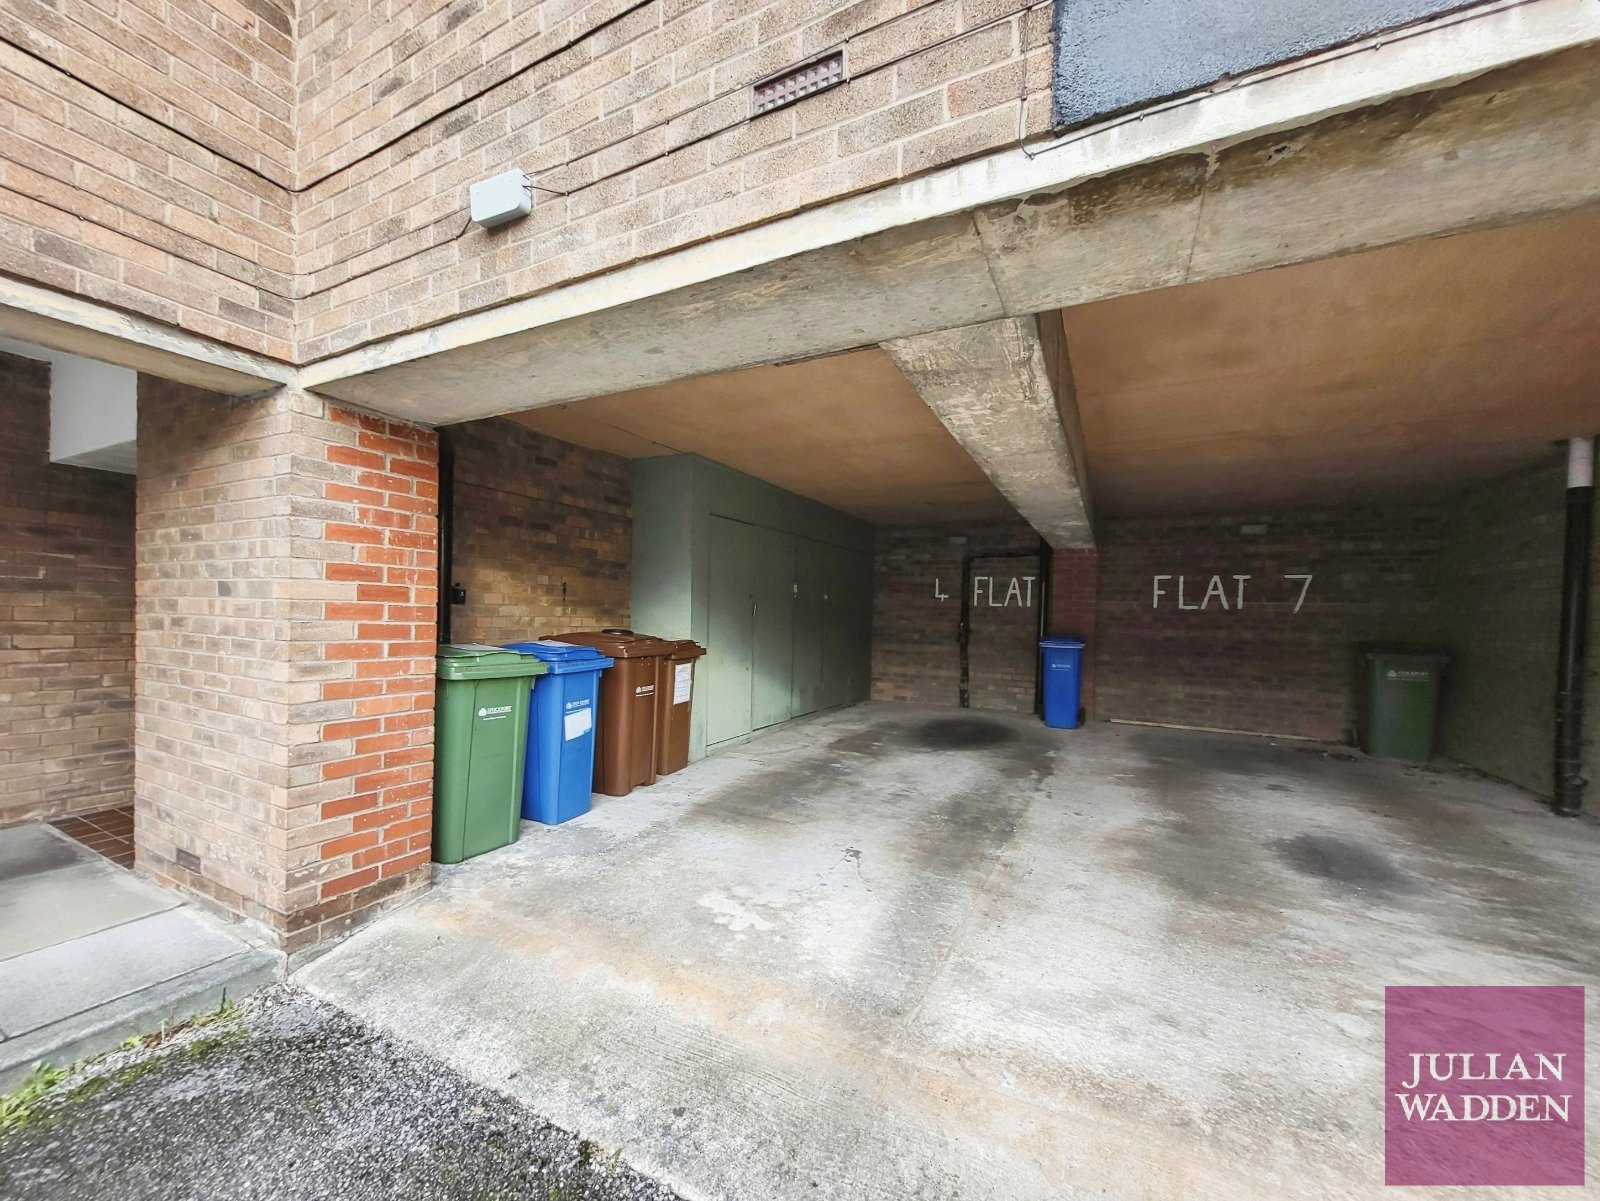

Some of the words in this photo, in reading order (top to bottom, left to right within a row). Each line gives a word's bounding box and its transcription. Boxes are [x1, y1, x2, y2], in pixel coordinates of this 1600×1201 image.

[934, 577, 950, 602] 4
[973, 576, 1036, 607] FLAT
[1152, 574, 1252, 610] FLAT
[1283, 574, 1313, 614] 7
